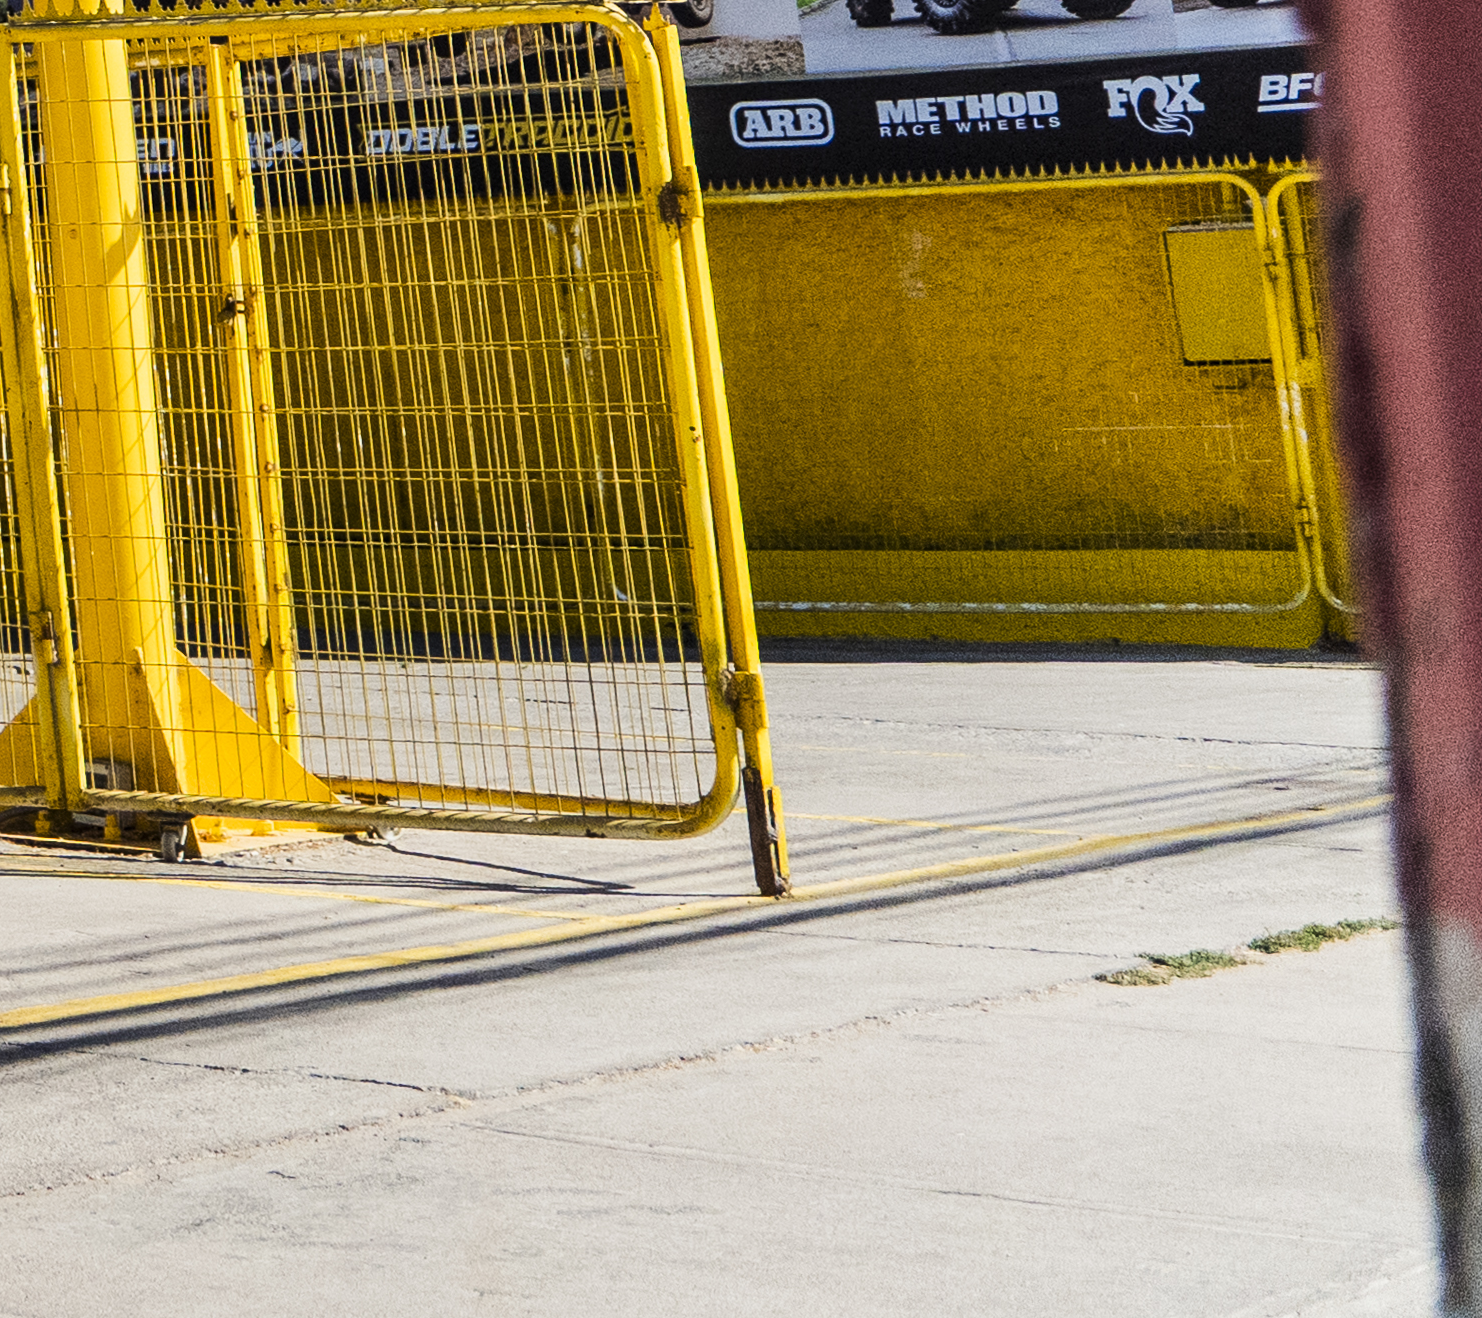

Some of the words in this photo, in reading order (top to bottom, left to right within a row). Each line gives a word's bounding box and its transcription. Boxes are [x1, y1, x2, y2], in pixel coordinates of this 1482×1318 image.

[875, 90, 1059, 125] METHOD
[1103, 73, 1205, 137] FOX
[743, 107, 826, 139] ARB
[879, 123, 943, 138] RACE
[955, 116, 1062, 134] WHEELS
